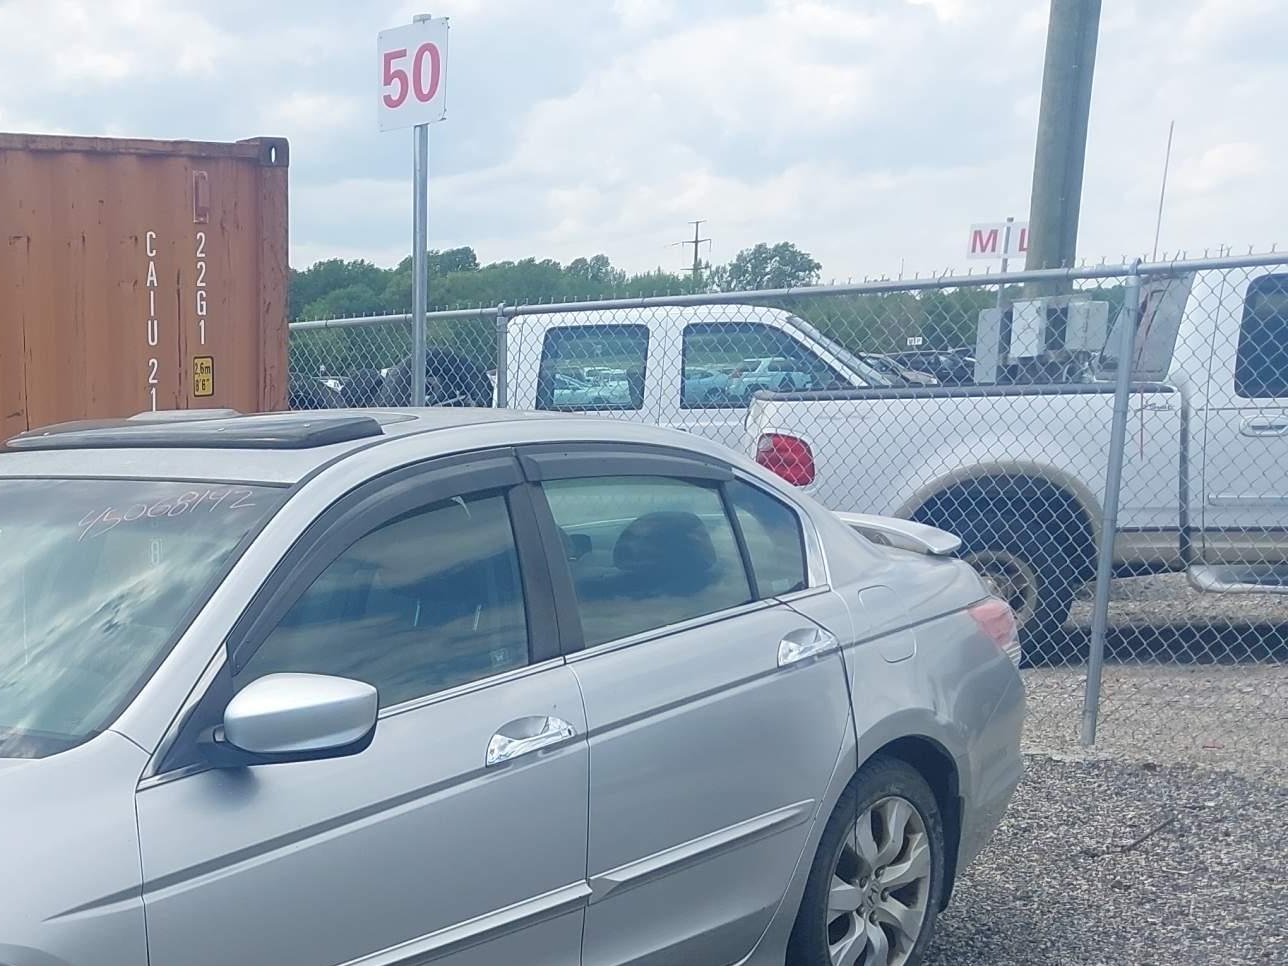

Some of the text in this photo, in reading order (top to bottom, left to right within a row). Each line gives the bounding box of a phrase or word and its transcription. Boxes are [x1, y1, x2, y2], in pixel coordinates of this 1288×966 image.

[382, 42, 441, 109] 50
[971, 228, 999, 253] M
[146, 231, 158, 346] CAIU
[196, 231, 207, 345] 22G1
[78, 488, 257, 542] 45068142
